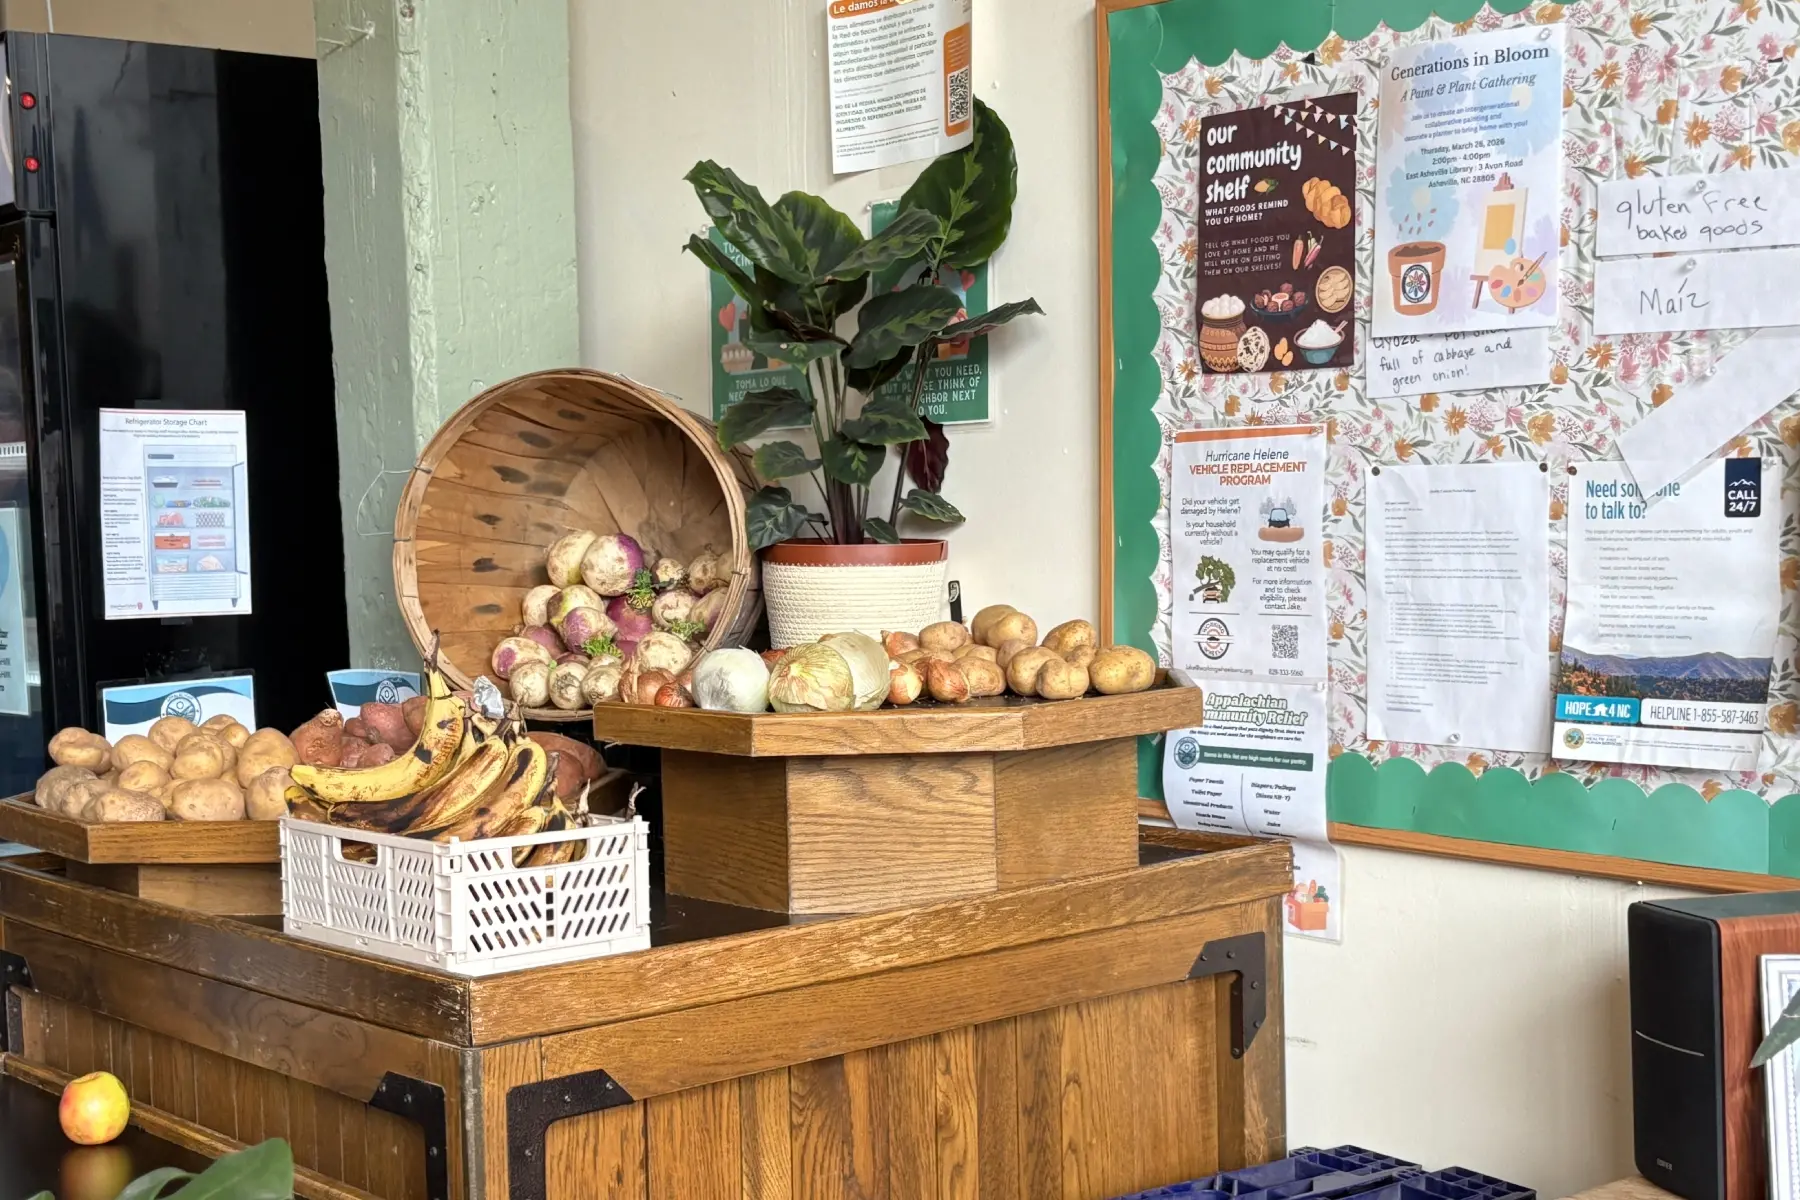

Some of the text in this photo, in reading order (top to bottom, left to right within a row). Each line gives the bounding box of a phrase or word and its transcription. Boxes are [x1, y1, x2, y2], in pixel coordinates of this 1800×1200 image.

[834, 0, 879, 14] Le damos
[1392, 47, 1549, 81] Generations in Bloom
[1400, 73, 1537, 102] A Paint & Plant Gathering
[1421, 146, 1450, 155] Thursday,
[1452, 141, 1473, 151] March
[1207, 140, 1301, 174] community
[1432, 153, 1490, 165] 2:00pm 4:00pm
[1420, 169, 1448, 178] Asheville
[1450, 166, 1473, 175] Library
[1485, 162, 1503, 170] Avon
[1428, 180, 1459, 188] Asheville,
[1473, 174, 1495, 182] 28805
[1205, 175, 1250, 203] shelf
[1205, 200, 1288, 216] WHAT FOODS REMIND
[1616, 186, 1691, 229] gluten
[1205, 213, 1263, 226] YOU OF HOME?
[1636, 220, 1763, 243] baked goods
[1253, 254, 1280, 262] GETTING
[1640, 277, 1711, 315] Maíz
[1380, 337, 1512, 372] full of cabbage and
[935, 367, 951, 378] YOU
[736, 376, 786, 389] TOMA LO QUE
[902, 381, 934, 394] PLSE
[939, 379, 965, 390] THINK
[970, 377, 980, 387] OF
[1392, 368, 1469, 393] green onion!
[906, 393, 948, 404] NGHBOR
[953, 390, 976, 401] NEXT
[928, 405, 948, 415] YOU.
[125, 418, 162, 426] Refrigerator
[1205, 448, 1289, 462] Hurricane Helene
[1190, 462, 1307, 475] VEHICLE REPLACEMENT
[1220, 475, 1271, 486] PROGRAM
[1586, 479, 1680, 499] Need sone
[1727, 489, 1758, 500] CALL
[1208, 497, 1227, 505] vehicle
[1729, 502, 1757, 513] 24/7
[1181, 507, 1207, 516] damaged
[1585, 500, 1648, 520] to talk to?
[1192, 522, 1204, 530] your
[1185, 529, 1209, 540] currently
[1276, 548, 1295, 557] qualify
[1288, 595, 1307, 603] please
[1206, 693, 1288, 710] Appalachian
[1565, 701, 1631, 718] HOPE 4 NC
[1650, 706, 1759, 725] HELPLINE 1-855-587-3463
[1203, 709, 1308, 726] mmunity Relief
